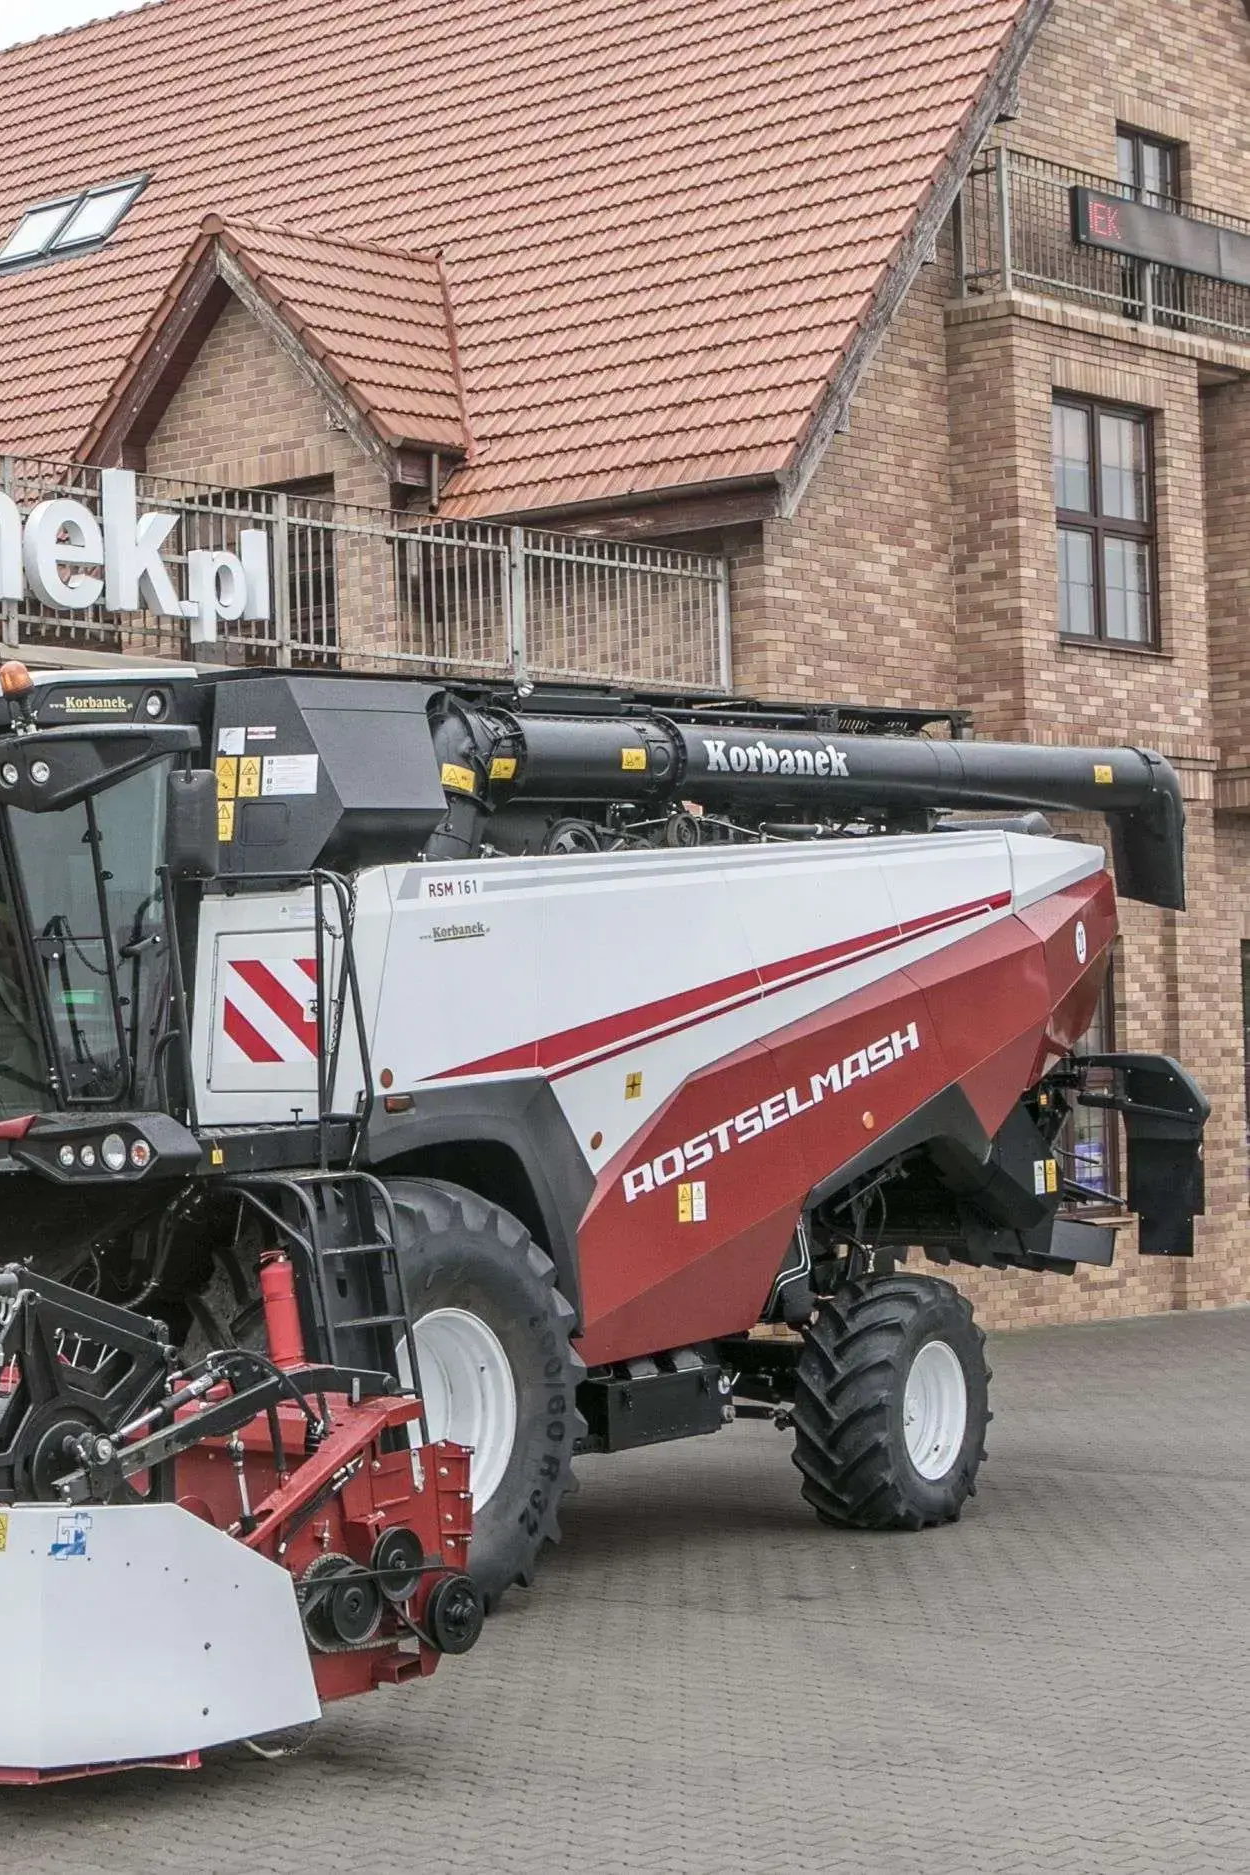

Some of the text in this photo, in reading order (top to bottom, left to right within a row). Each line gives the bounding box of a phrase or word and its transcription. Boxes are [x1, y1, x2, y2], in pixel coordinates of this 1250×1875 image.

[702, 740, 850, 777] Korbanek
[428, 879, 478, 898] RSM 161
[622, 1021, 920, 1203] ROSTSELMASH
